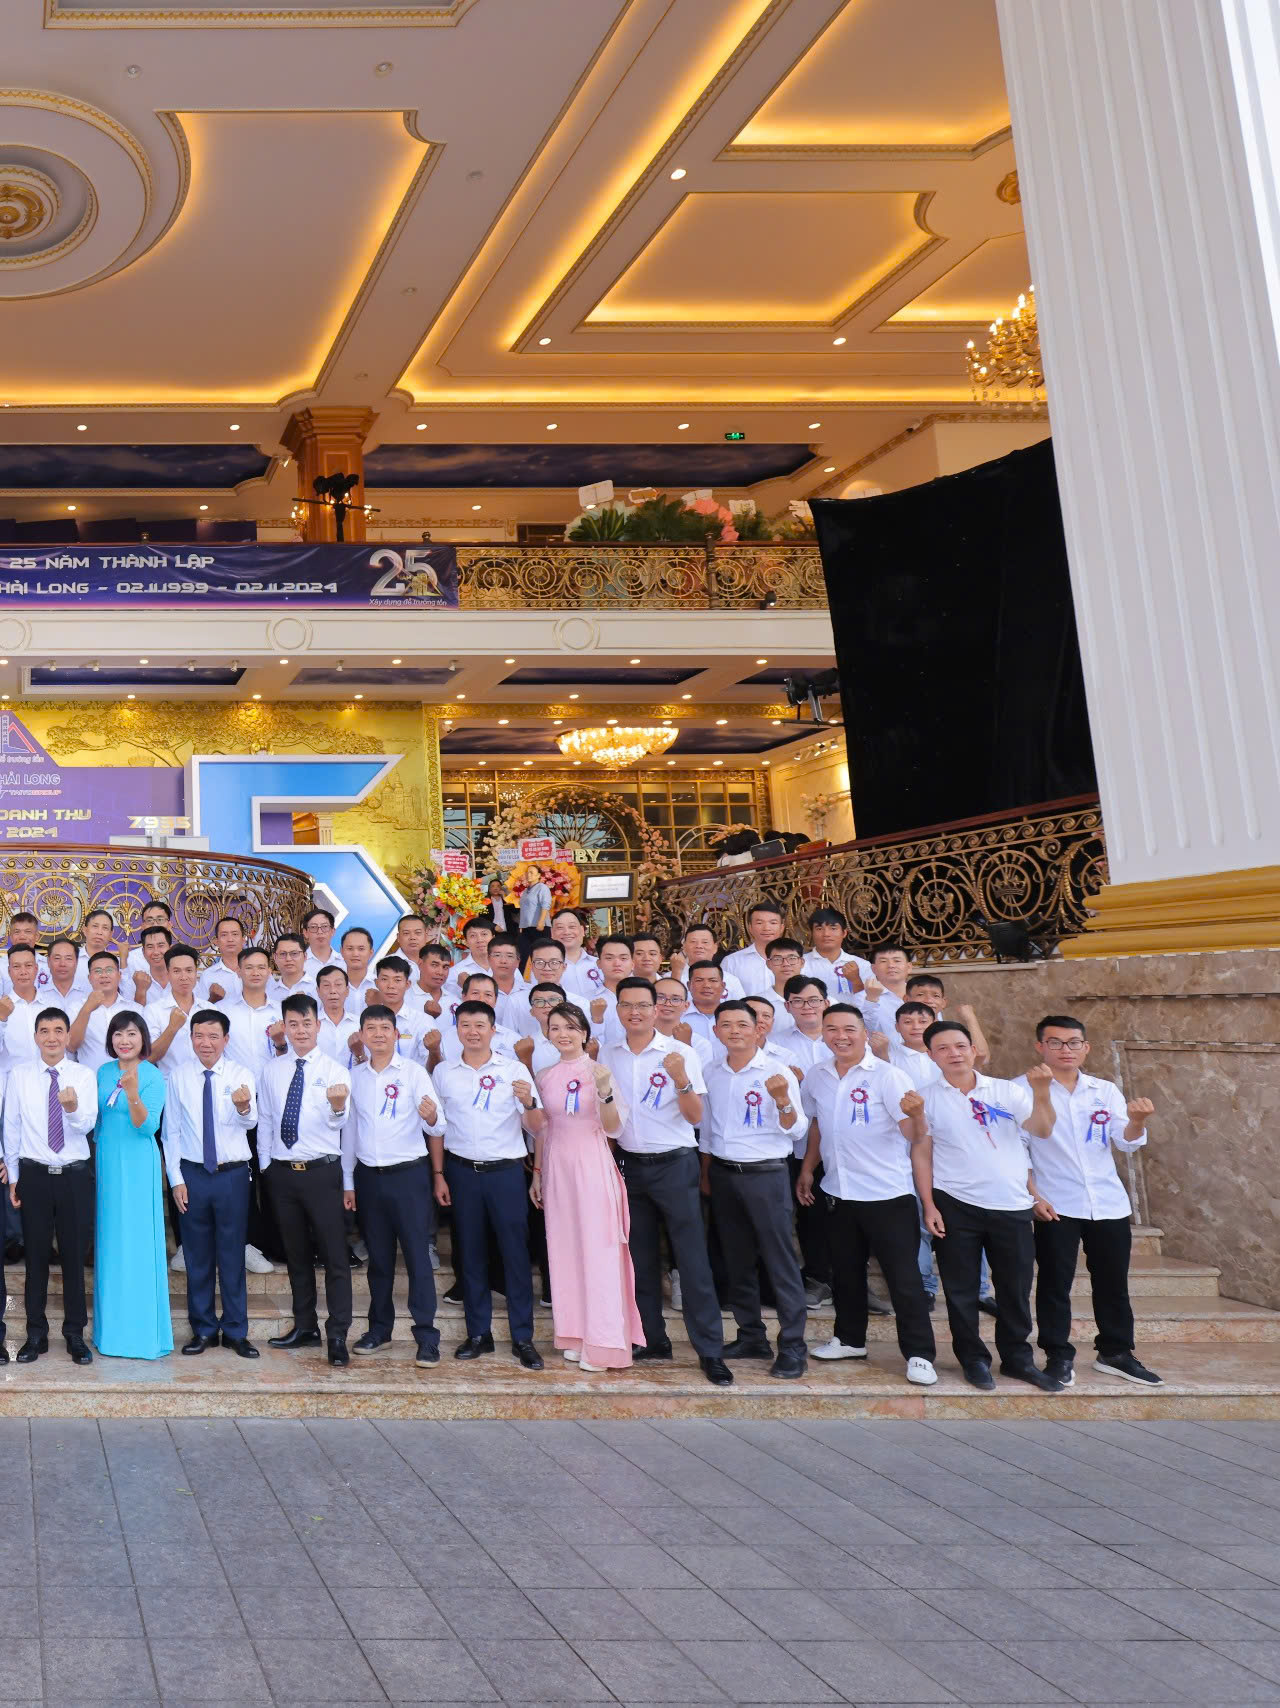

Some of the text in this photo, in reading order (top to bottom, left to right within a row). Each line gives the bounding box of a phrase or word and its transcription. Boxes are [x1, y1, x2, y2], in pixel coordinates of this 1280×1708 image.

[9, 558, 36, 568] 25
[46, 555, 90, 569] NĂM
[98, 554, 168, 569] THÀNH
[174, 554, 214, 570] LẬP
[369, 548, 439, 596] 25
[36, 582, 89, 594] LONG
[24, 774, 61, 785] LONG
[53, 810, 92, 820] THU
[6, 826, 58, 838] 2024
